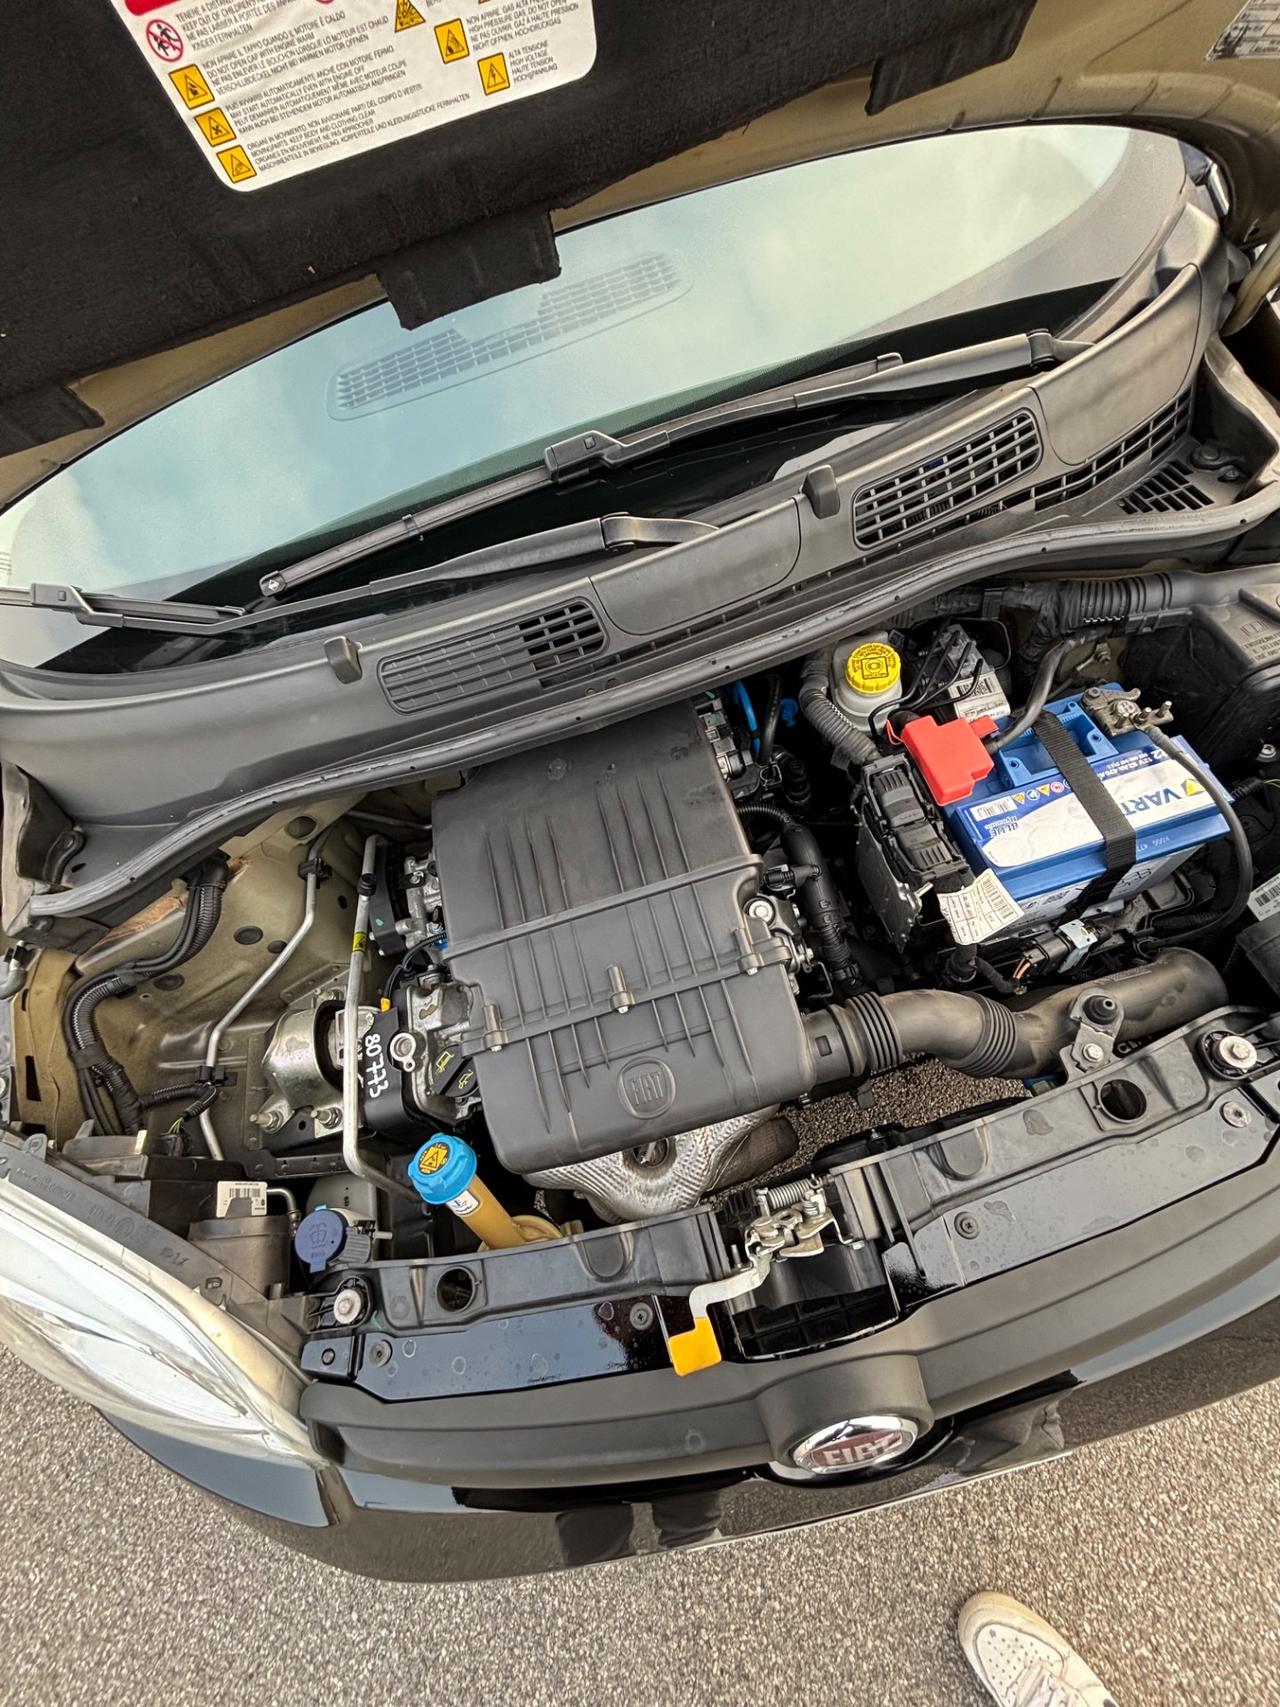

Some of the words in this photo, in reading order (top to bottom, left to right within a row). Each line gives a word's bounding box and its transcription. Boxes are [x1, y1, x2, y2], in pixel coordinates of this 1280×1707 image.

[181, 20, 198, 31] KEEP
[197, 15, 212, 25] OUT
[467, 15, 479, 23] NON
[469, 24, 482, 32] HIGH
[484, 14, 512, 27] PRESSURE
[538, 2, 548, 10] NOT
[514, 19, 525, 27] GAZ
[531, 11, 549, 22] HAUTE
[550, 2, 578, 15] PRESSION
[196, 27, 208, 37] PAS
[202, 60, 217, 69] NON
[262, 31, 288, 46] QUANDO
[294, 21, 319, 34] MOTORE
[325, 11, 345, 23] CALDO
[474, 41, 489, 50] NICHT
[217, 65, 230, 73] NOT
[229, 58, 247, 69] OPEN
[246, 53, 259, 62] CAP
[259, 47, 274, 57] WITH
[274, 39, 296, 51] ENGINE
[296, 32, 314, 43] WARM
[221, 74, 233, 82] PAS
[233, 64, 258, 78] ENLEVER
[266, 49, 295, 65] BOUCHON
[295, 40, 322, 54] LORSQUE
[331, 27, 356, 41] MOTEUR
[356, 23, 367, 32] EST
[368, 15, 389, 28] CHAUD
[270, 63, 288, 73] NICHT
[324, 42, 345, 53] MOTOR
[508, 49, 521, 58] ALTA
[522, 40, 548, 54] TENSIONE
[524, 49, 547, 61] VOLTAGE
[263, 73, 315, 98] AUTOMATICAMENTE
[316, 66, 335, 77] ANCHE
[336, 61, 349, 70] CON
[349, 53, 373, 66] MOTORE
[373, 45, 393, 58] FERMO
[512, 64, 529, 73] HAUTE
[531, 56, 553, 67] TENSION
[230, 110, 242, 118] MAY
[243, 104, 259, 113] START
[260, 88, 302, 108] AUTOMATICALLY
[302, 82, 318, 92] EVEN
[318, 77, 332, 86] WITH
[332, 69, 353, 81] ENGINE
[354, 65, 365, 74] OFF
[234, 117, 249, 126] PEUT
[279, 86, 331, 110] AUTOMATIQUEMENT
[349, 75, 364, 85] AVEC
[364, 67, 387, 79] MOTEUR
[239, 125, 254, 133] KANN
[254, 118, 270, 128] AUCH
[279, 102, 313, 119] STEHENDEM
[312, 95, 332, 107] MOTOR
[332, 81, 370, 100] AUTOMATISCH
[371, 69, 405, 86] ANSPRINGEN
[351, 103, 366, 112] PARTI
[367, 99, 377, 107] DEL
[377, 92, 397, 103] CORPO
[255, 151, 280, 164] ORGANES
[342, 118, 373, 133] APPROCHER
[289, 134, 303, 143] KEEP
[304, 129, 318, 138] BODY
[331, 115, 357, 128] CLOTHING
[358, 109, 375, 119] CLEAR
[375, 122, 387, 130] UND
[1121, 788, 1182, 816] VART
[990, 822, 1018, 837] BLUE
[364, 1033, 389, 1098] 80773
[629, 1071, 666, 1105] FIAT
[823, 1433, 896, 1467] FIAT
